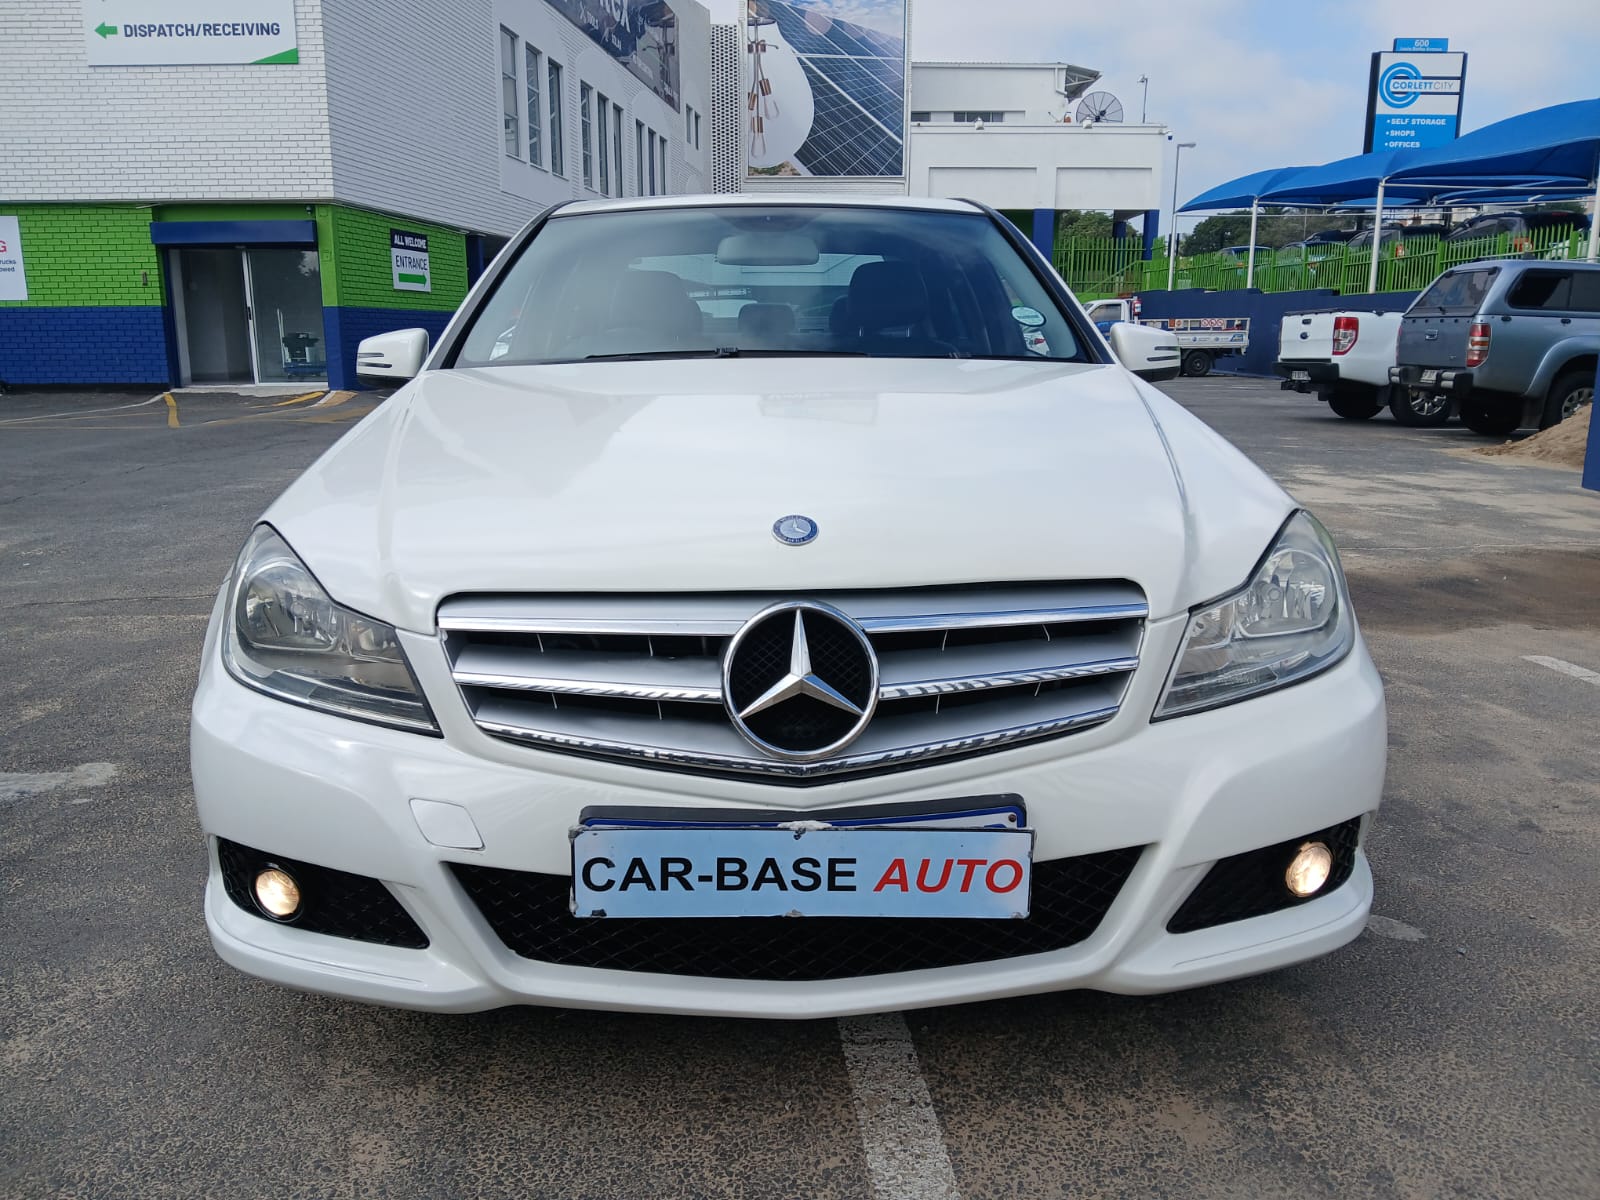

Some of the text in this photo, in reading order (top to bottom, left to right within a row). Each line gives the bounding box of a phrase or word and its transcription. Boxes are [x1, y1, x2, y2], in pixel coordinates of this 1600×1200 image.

[123, 22, 281, 38] DISPATCH/RECEIVING
[1414, 39, 1430, 47] 600
[394, 234, 427, 249] ALL WELCOME
[395, 255, 428, 271] ENTRANCE
[581, 856, 1024, 893] CAR-BASE AUTO
